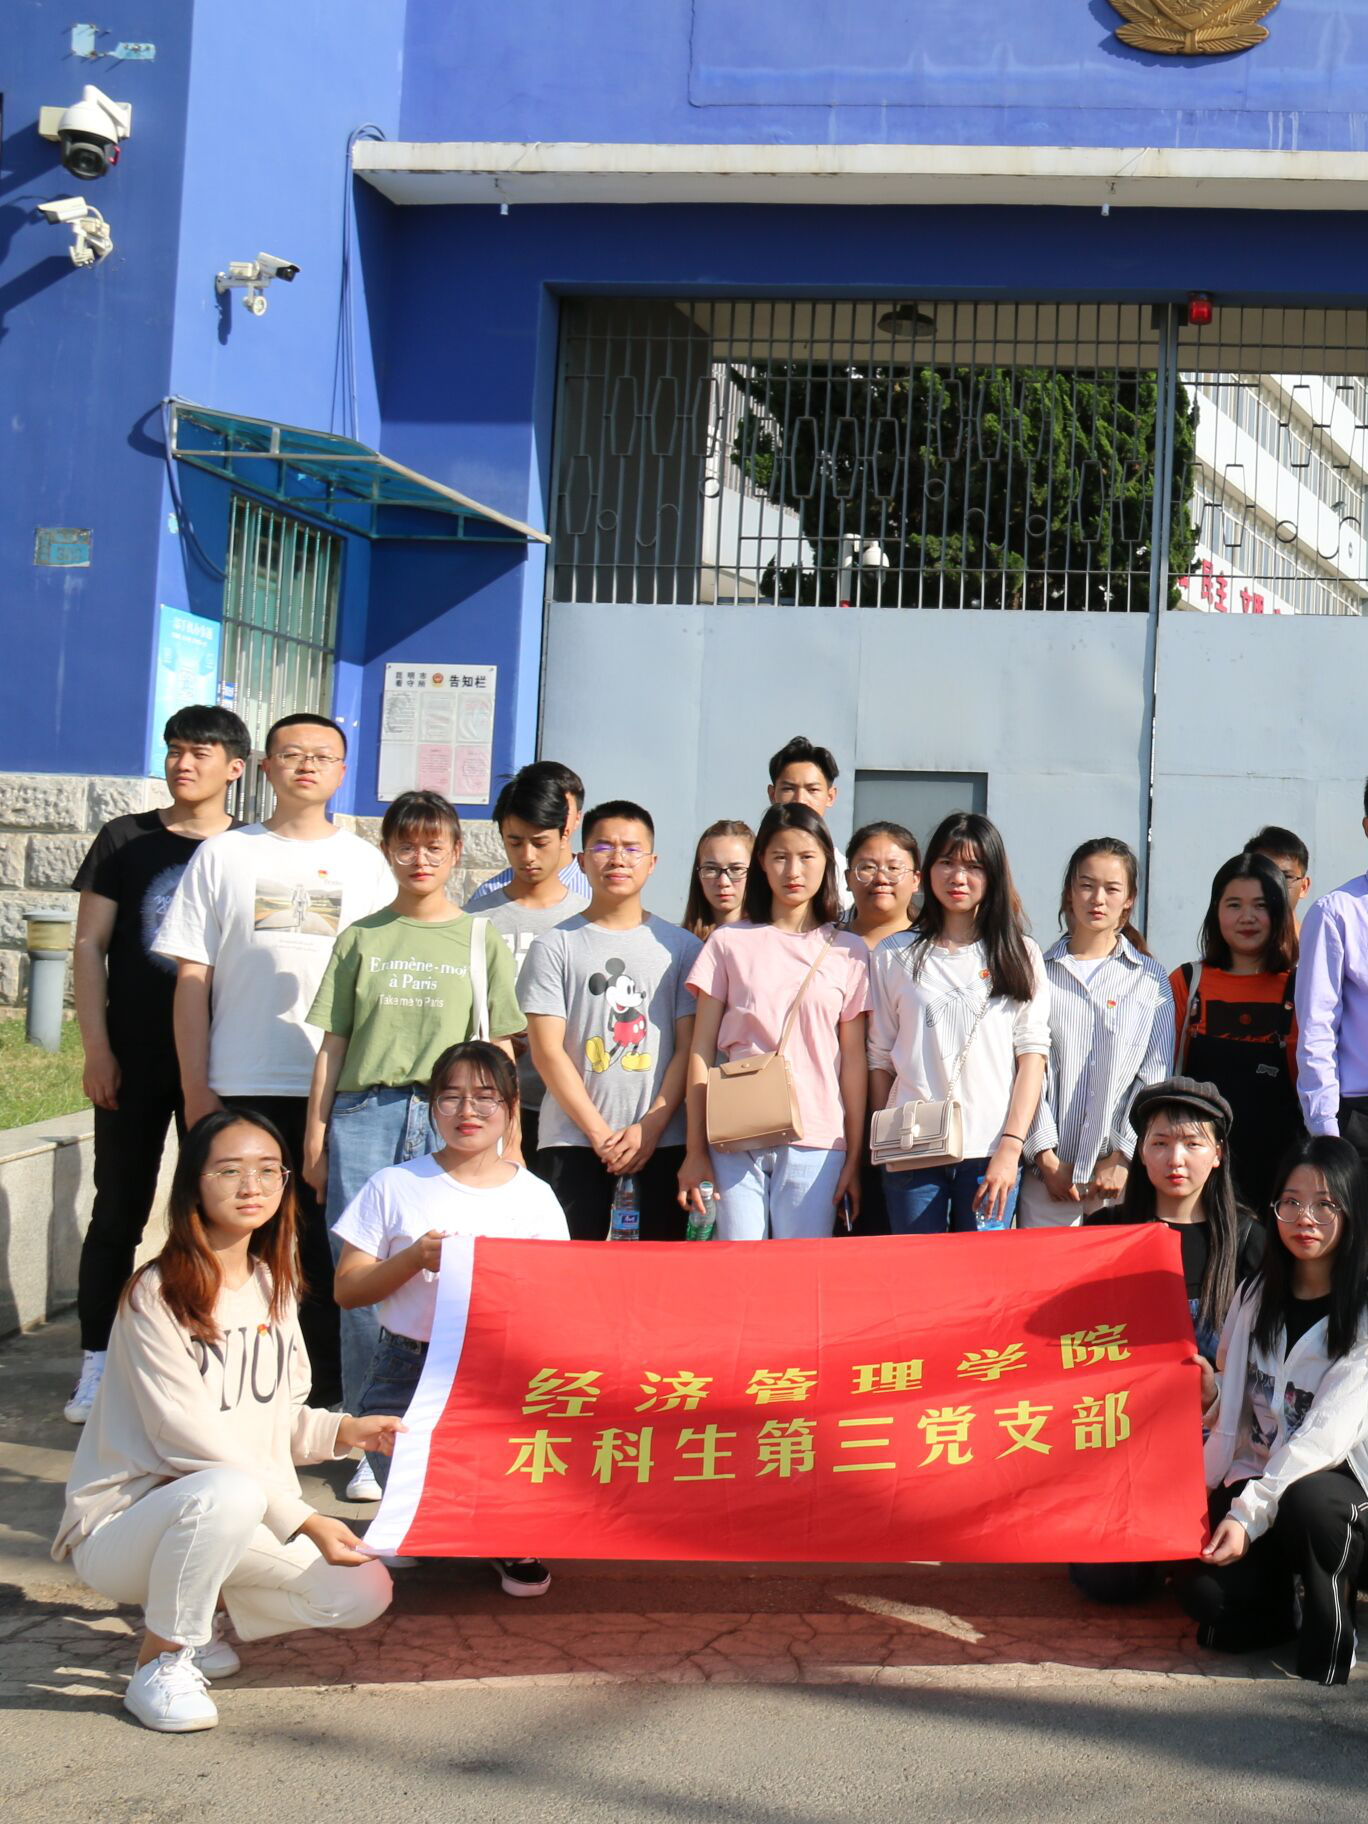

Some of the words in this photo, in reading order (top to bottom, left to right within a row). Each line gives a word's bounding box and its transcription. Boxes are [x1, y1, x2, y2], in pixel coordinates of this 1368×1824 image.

[449, 675, 487, 688] 告知栏
[389, 974, 398, 988] à
[402, 973, 437, 990] Paris
[380, 994, 399, 1006] Take
[400, 997, 413, 1007] me
[425, 997, 445, 1008] Paris
[522, 1322, 1133, 1418] 经济管理学院
[505, 1390, 1132, 1484] 本科生第三党支部
